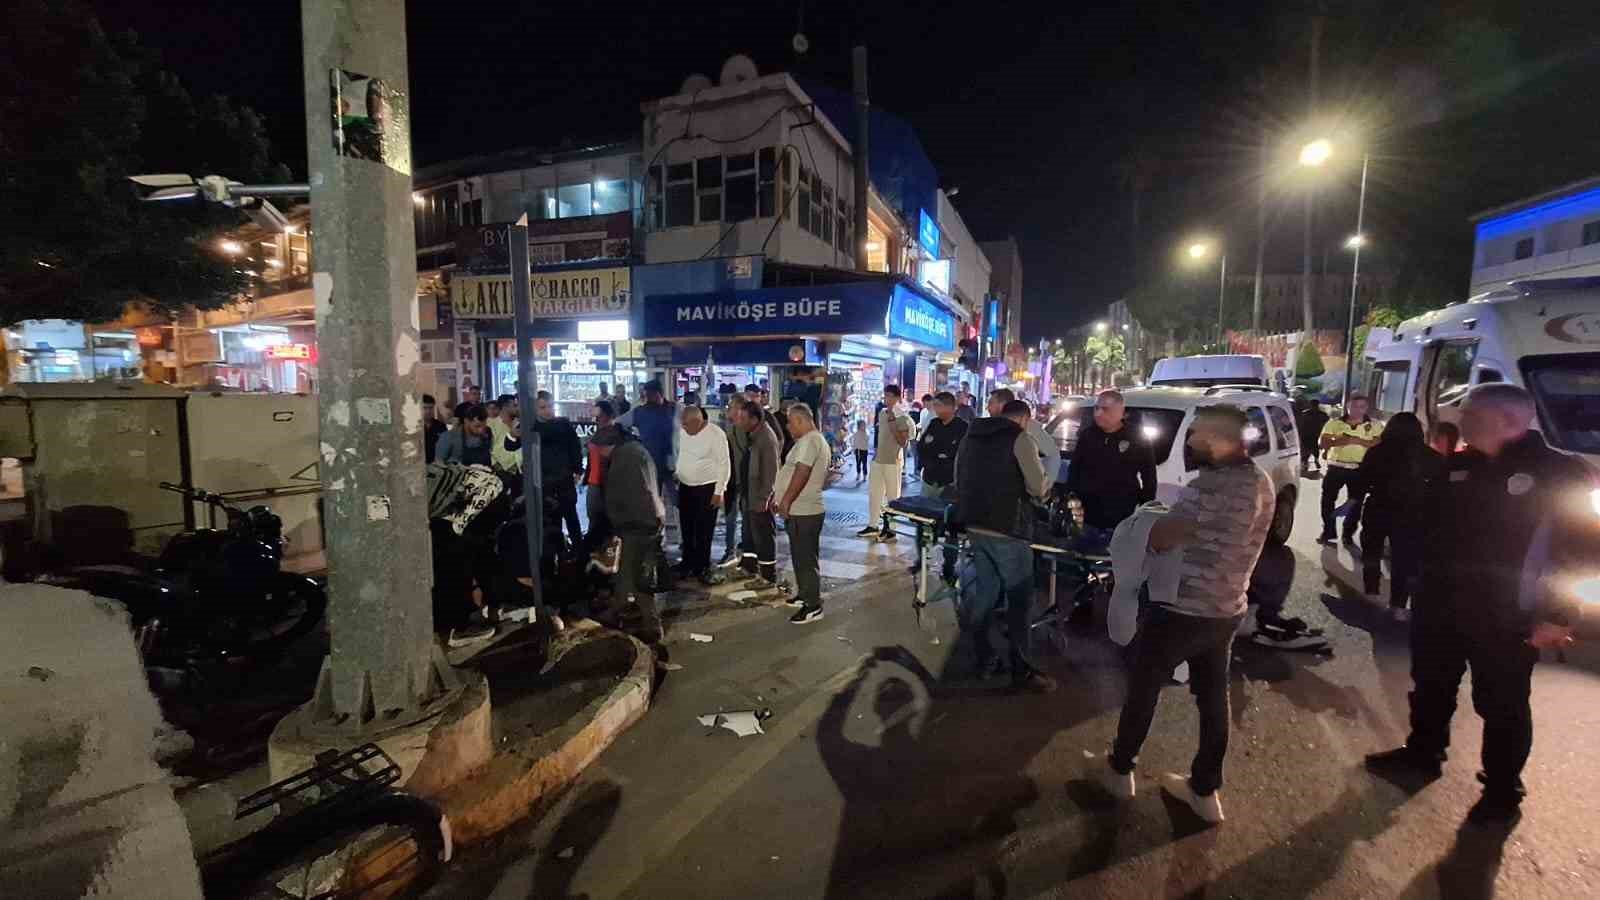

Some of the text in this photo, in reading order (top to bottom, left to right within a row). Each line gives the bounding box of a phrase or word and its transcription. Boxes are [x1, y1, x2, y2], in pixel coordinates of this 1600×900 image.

[477, 280, 515, 315] AKI
[676, 298, 841, 322] MAVİKÖŞE BÜFE
